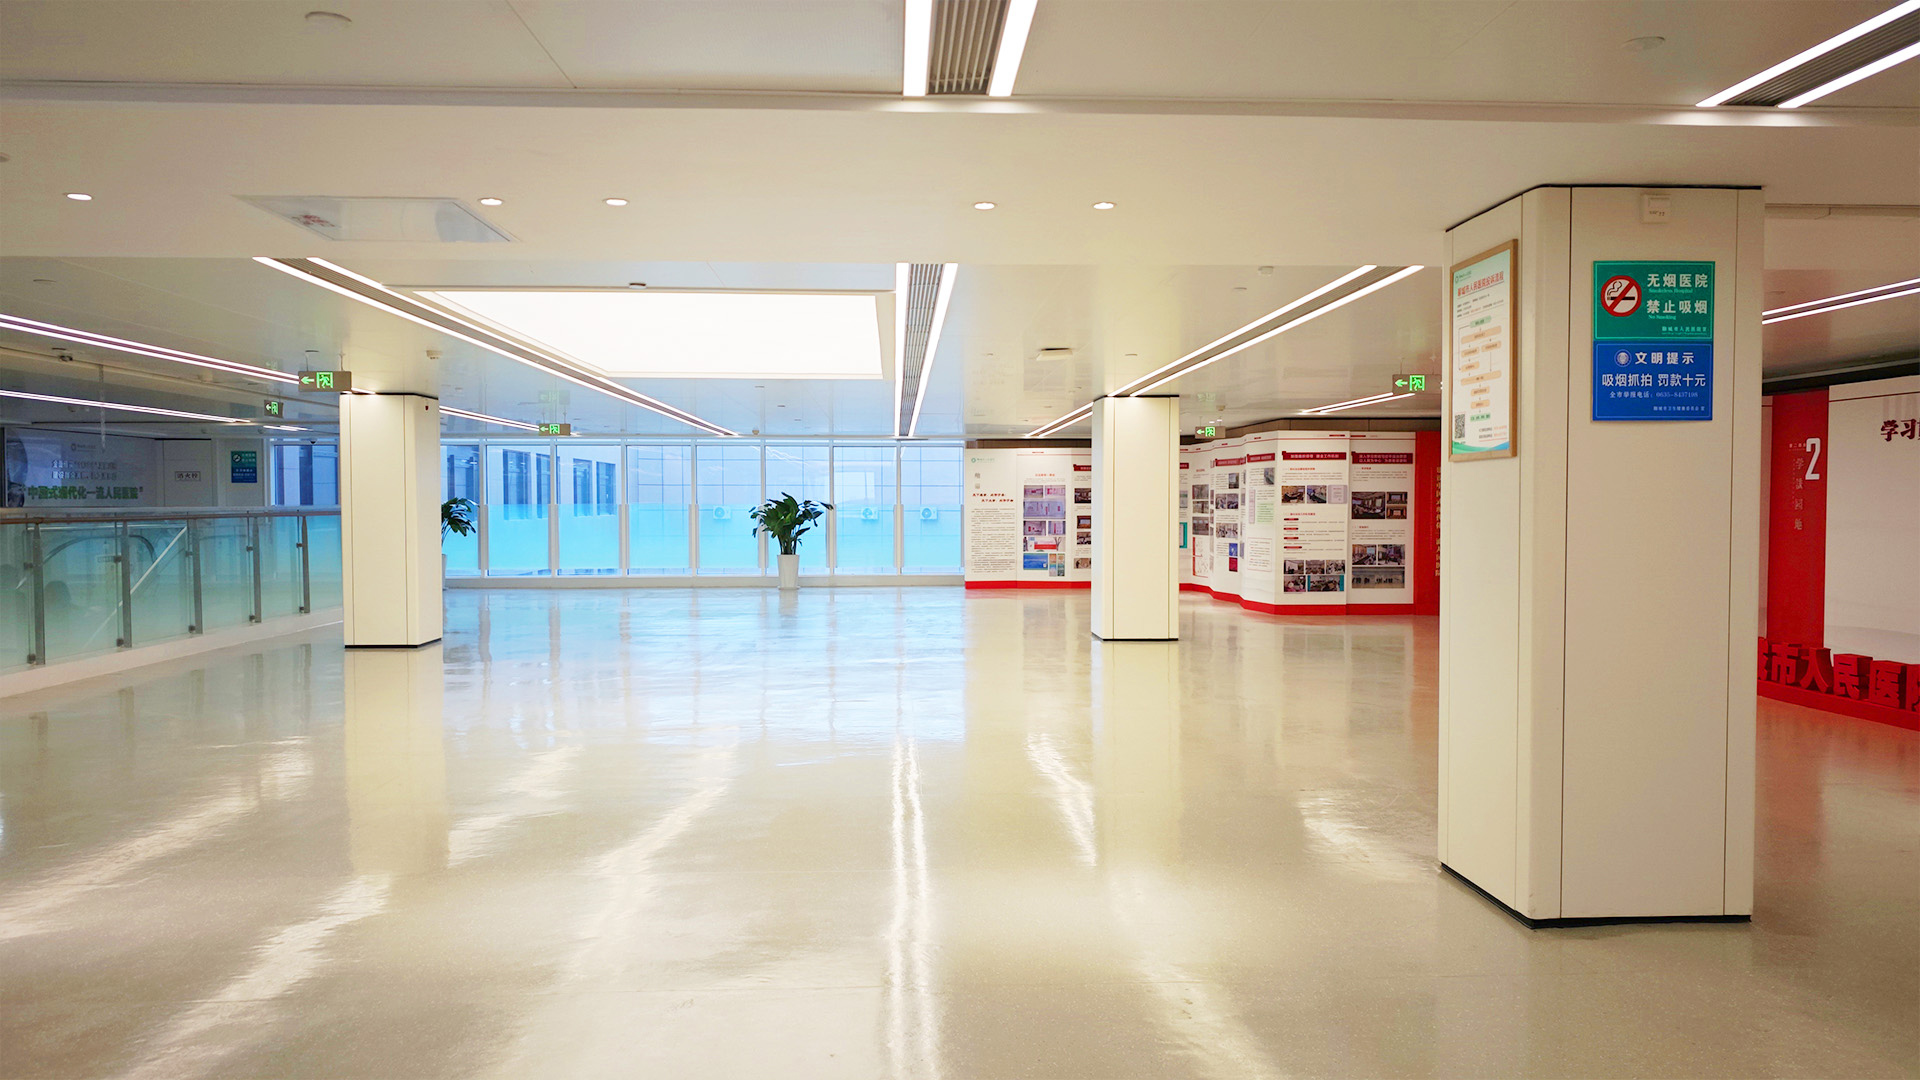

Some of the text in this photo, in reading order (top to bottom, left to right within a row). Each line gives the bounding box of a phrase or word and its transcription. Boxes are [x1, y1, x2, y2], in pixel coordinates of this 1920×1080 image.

[1646, 273, 1709, 288] 无烟医院
[1646, 299, 1708, 314] 禁止吸烟
[1634, 352, 1695, 365] 文明提示
[1601, 373, 1706, 387] 吸烟抓拍 罚款十元
[1880, 418, 1920, 442] 学习
[1805, 437, 1821, 481] 2
